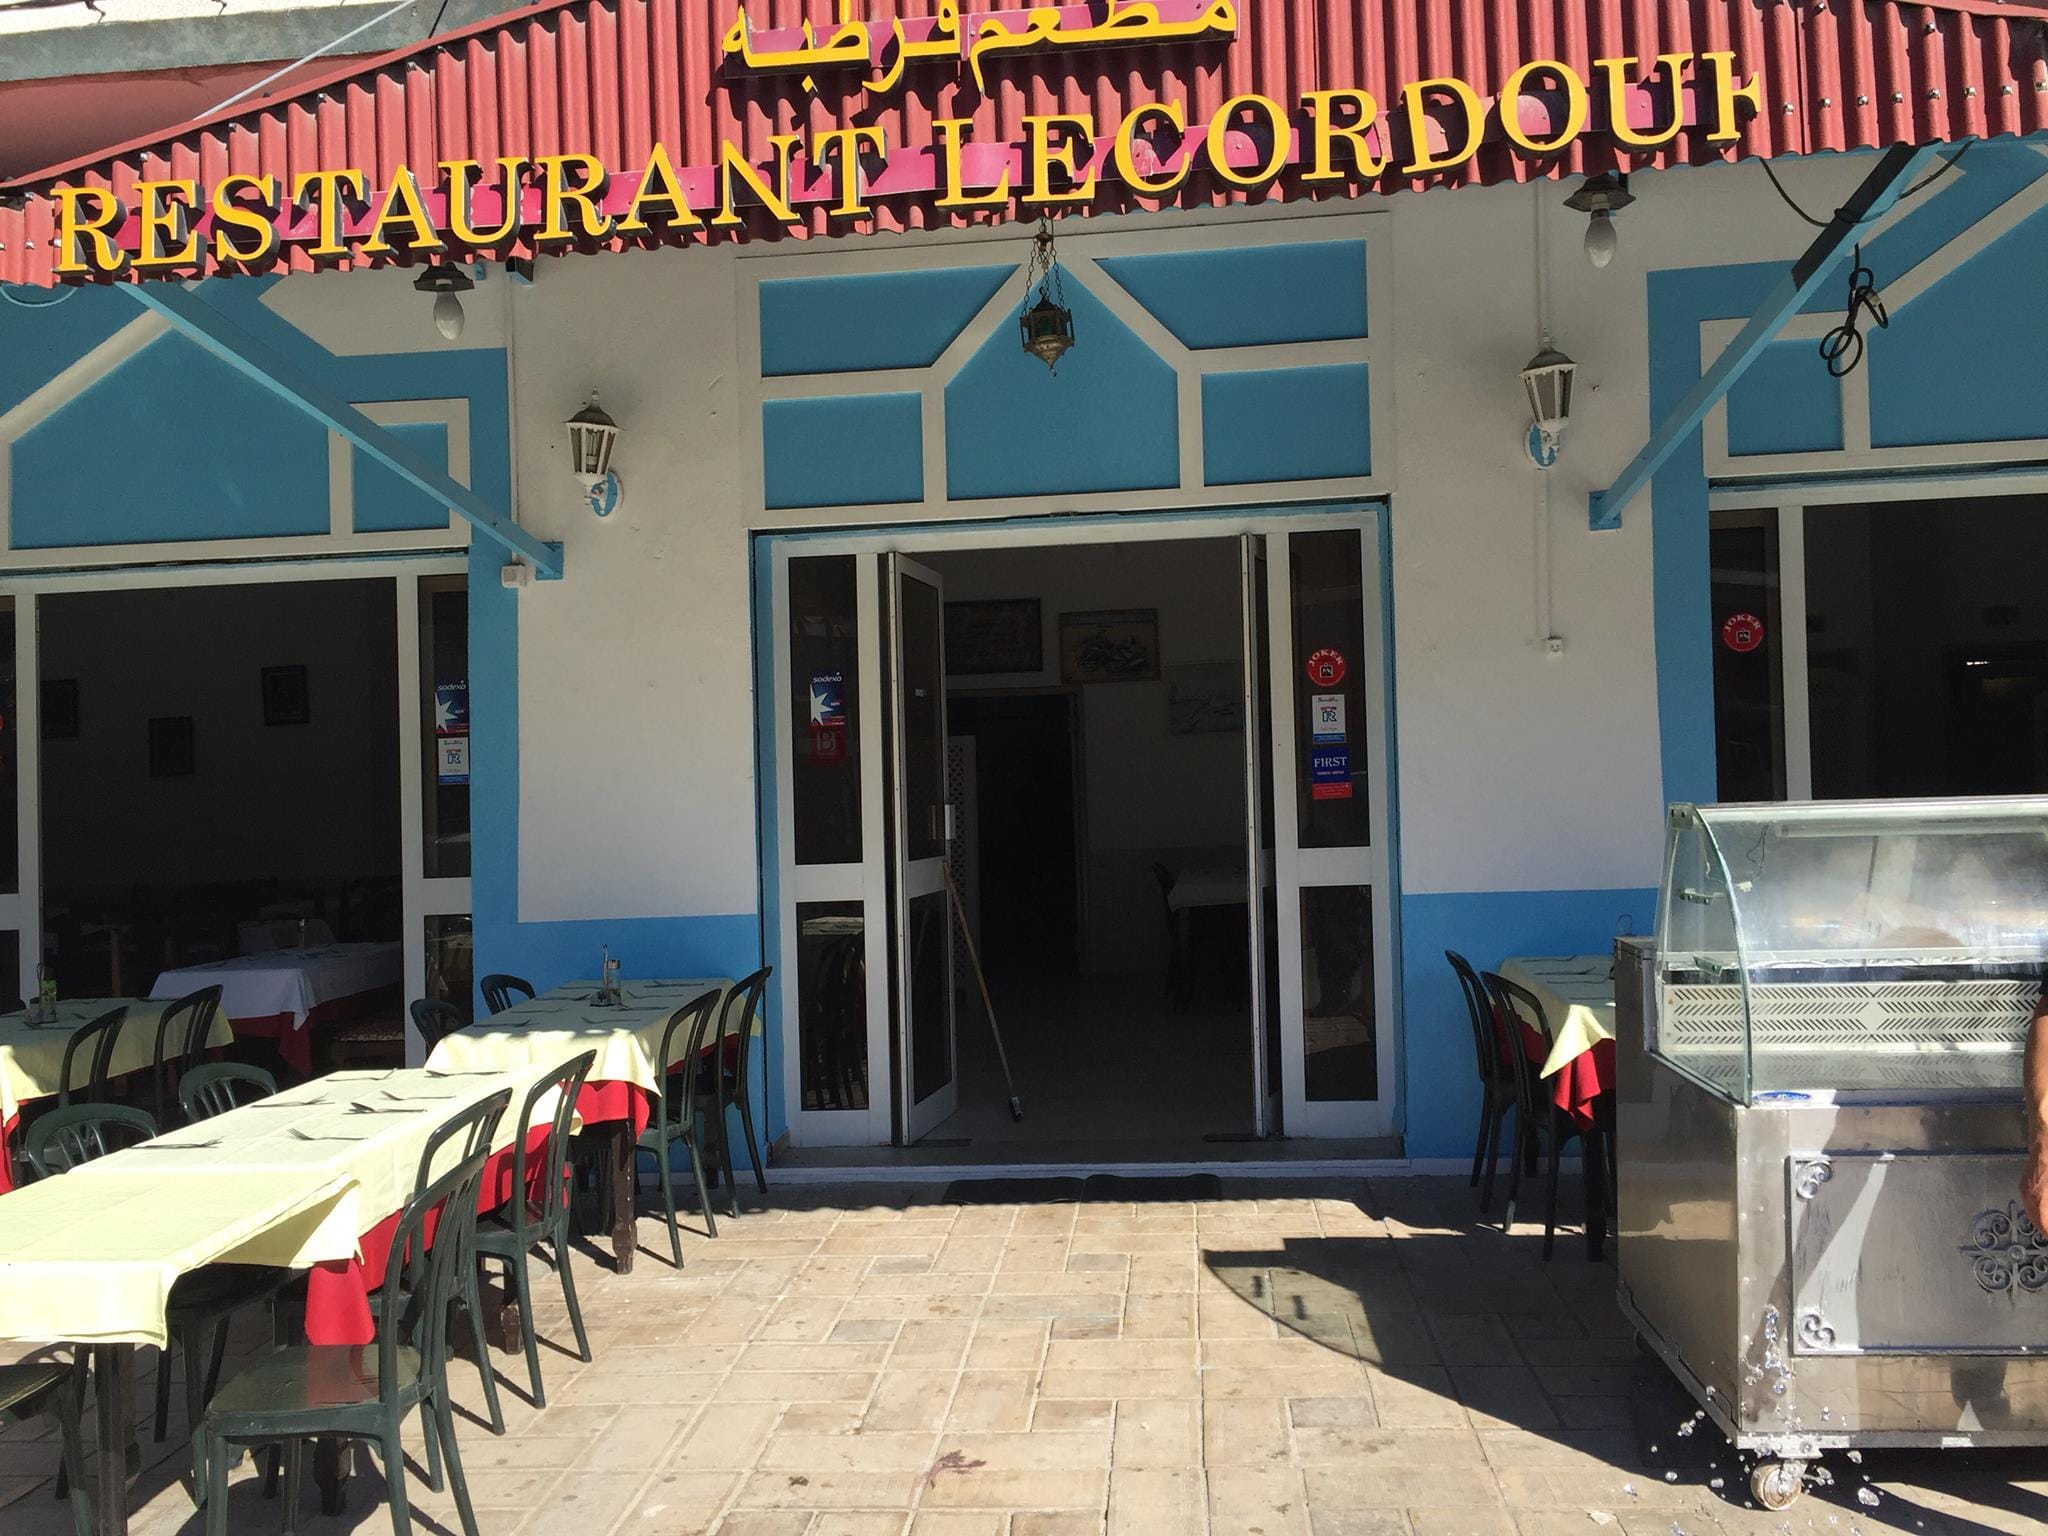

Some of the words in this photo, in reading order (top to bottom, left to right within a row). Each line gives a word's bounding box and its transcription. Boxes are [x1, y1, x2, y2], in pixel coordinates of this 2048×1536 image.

[970, 0, 1237, 97] مطعم
[52, 127, 884, 273] RESTAURANT
[1724, 614, 1761, 632] JOKER
[1308, 648, 1344, 667] JOKER
[437, 679, 467, 691] sodexo
[812, 672, 843, 683] sodexo
[1313, 756, 1348, 768] FIRST
